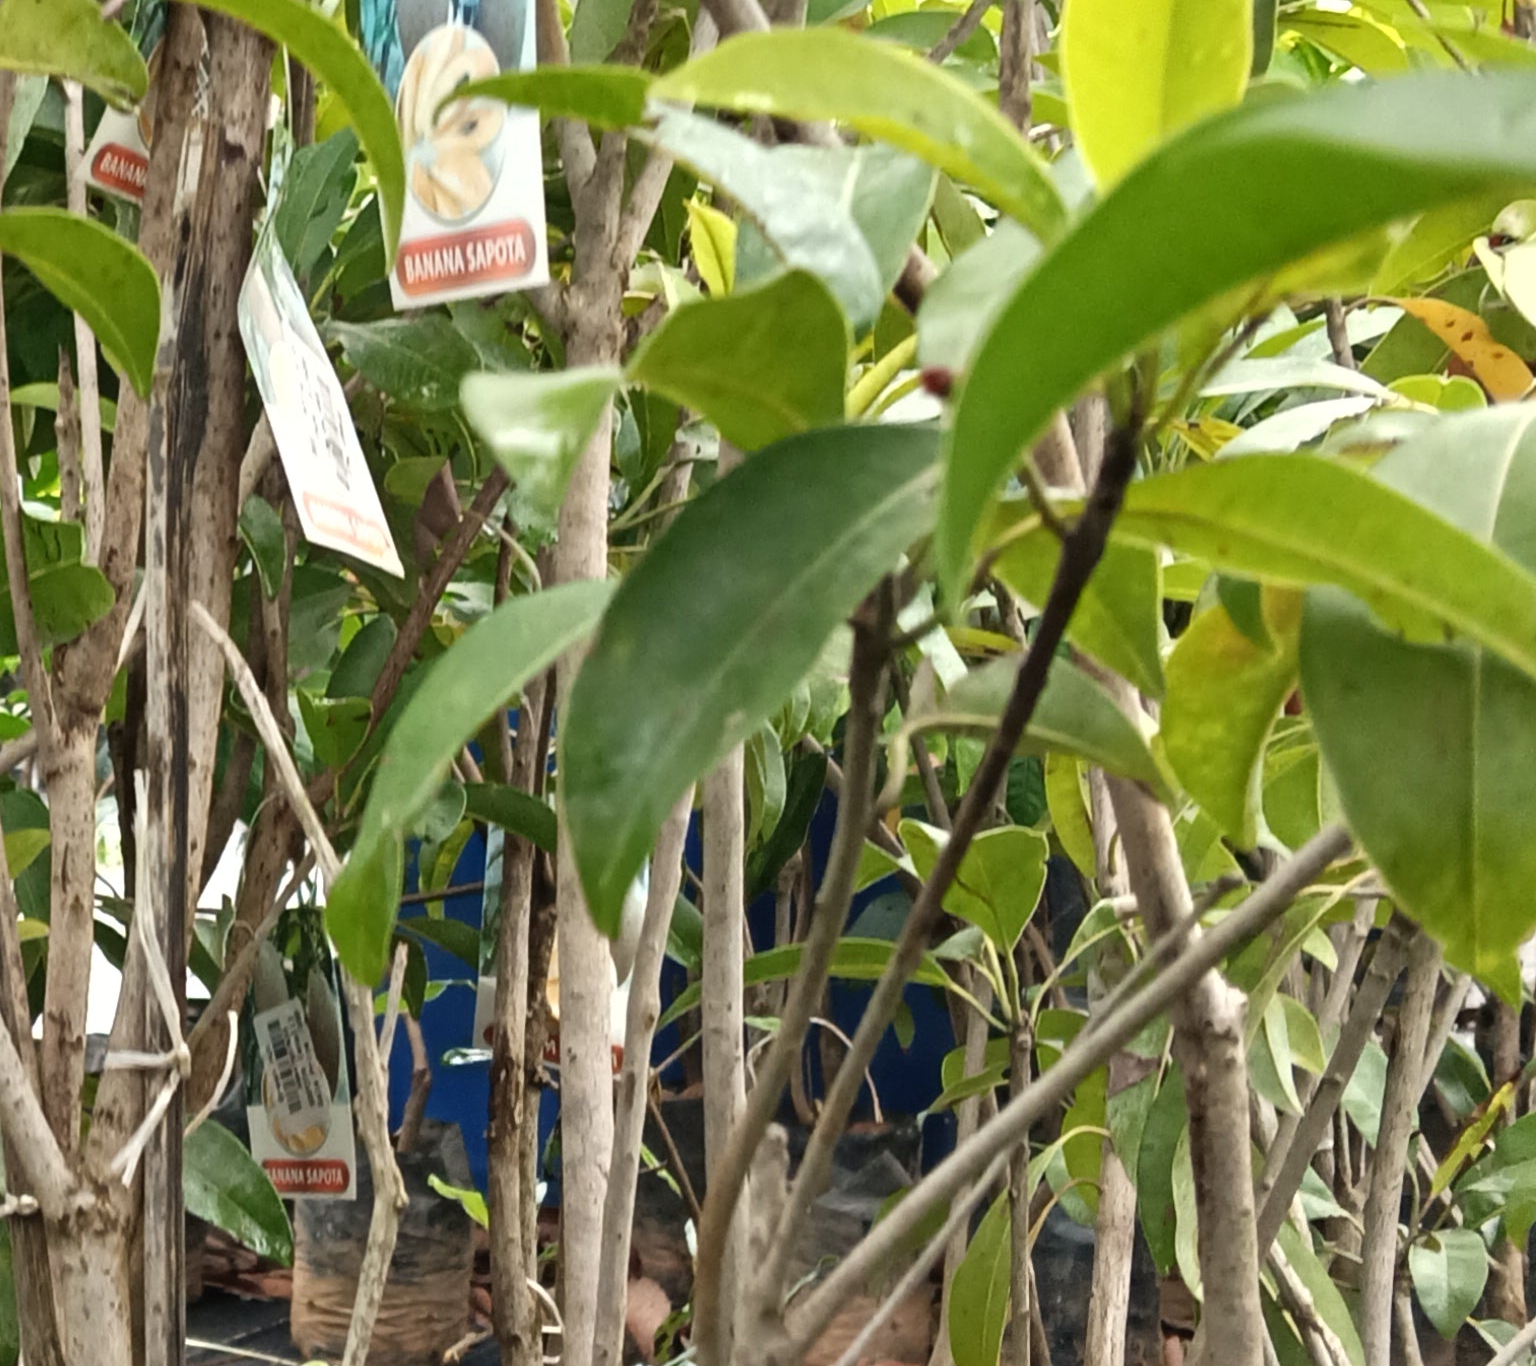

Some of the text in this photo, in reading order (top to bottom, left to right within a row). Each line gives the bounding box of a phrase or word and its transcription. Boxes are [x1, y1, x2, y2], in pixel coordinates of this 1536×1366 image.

[99, 151, 147, 188] BANAN
[404, 234, 526, 284] BANANA SAPOTA
[267, 1167, 344, 1186] ANANA SAPOTA
